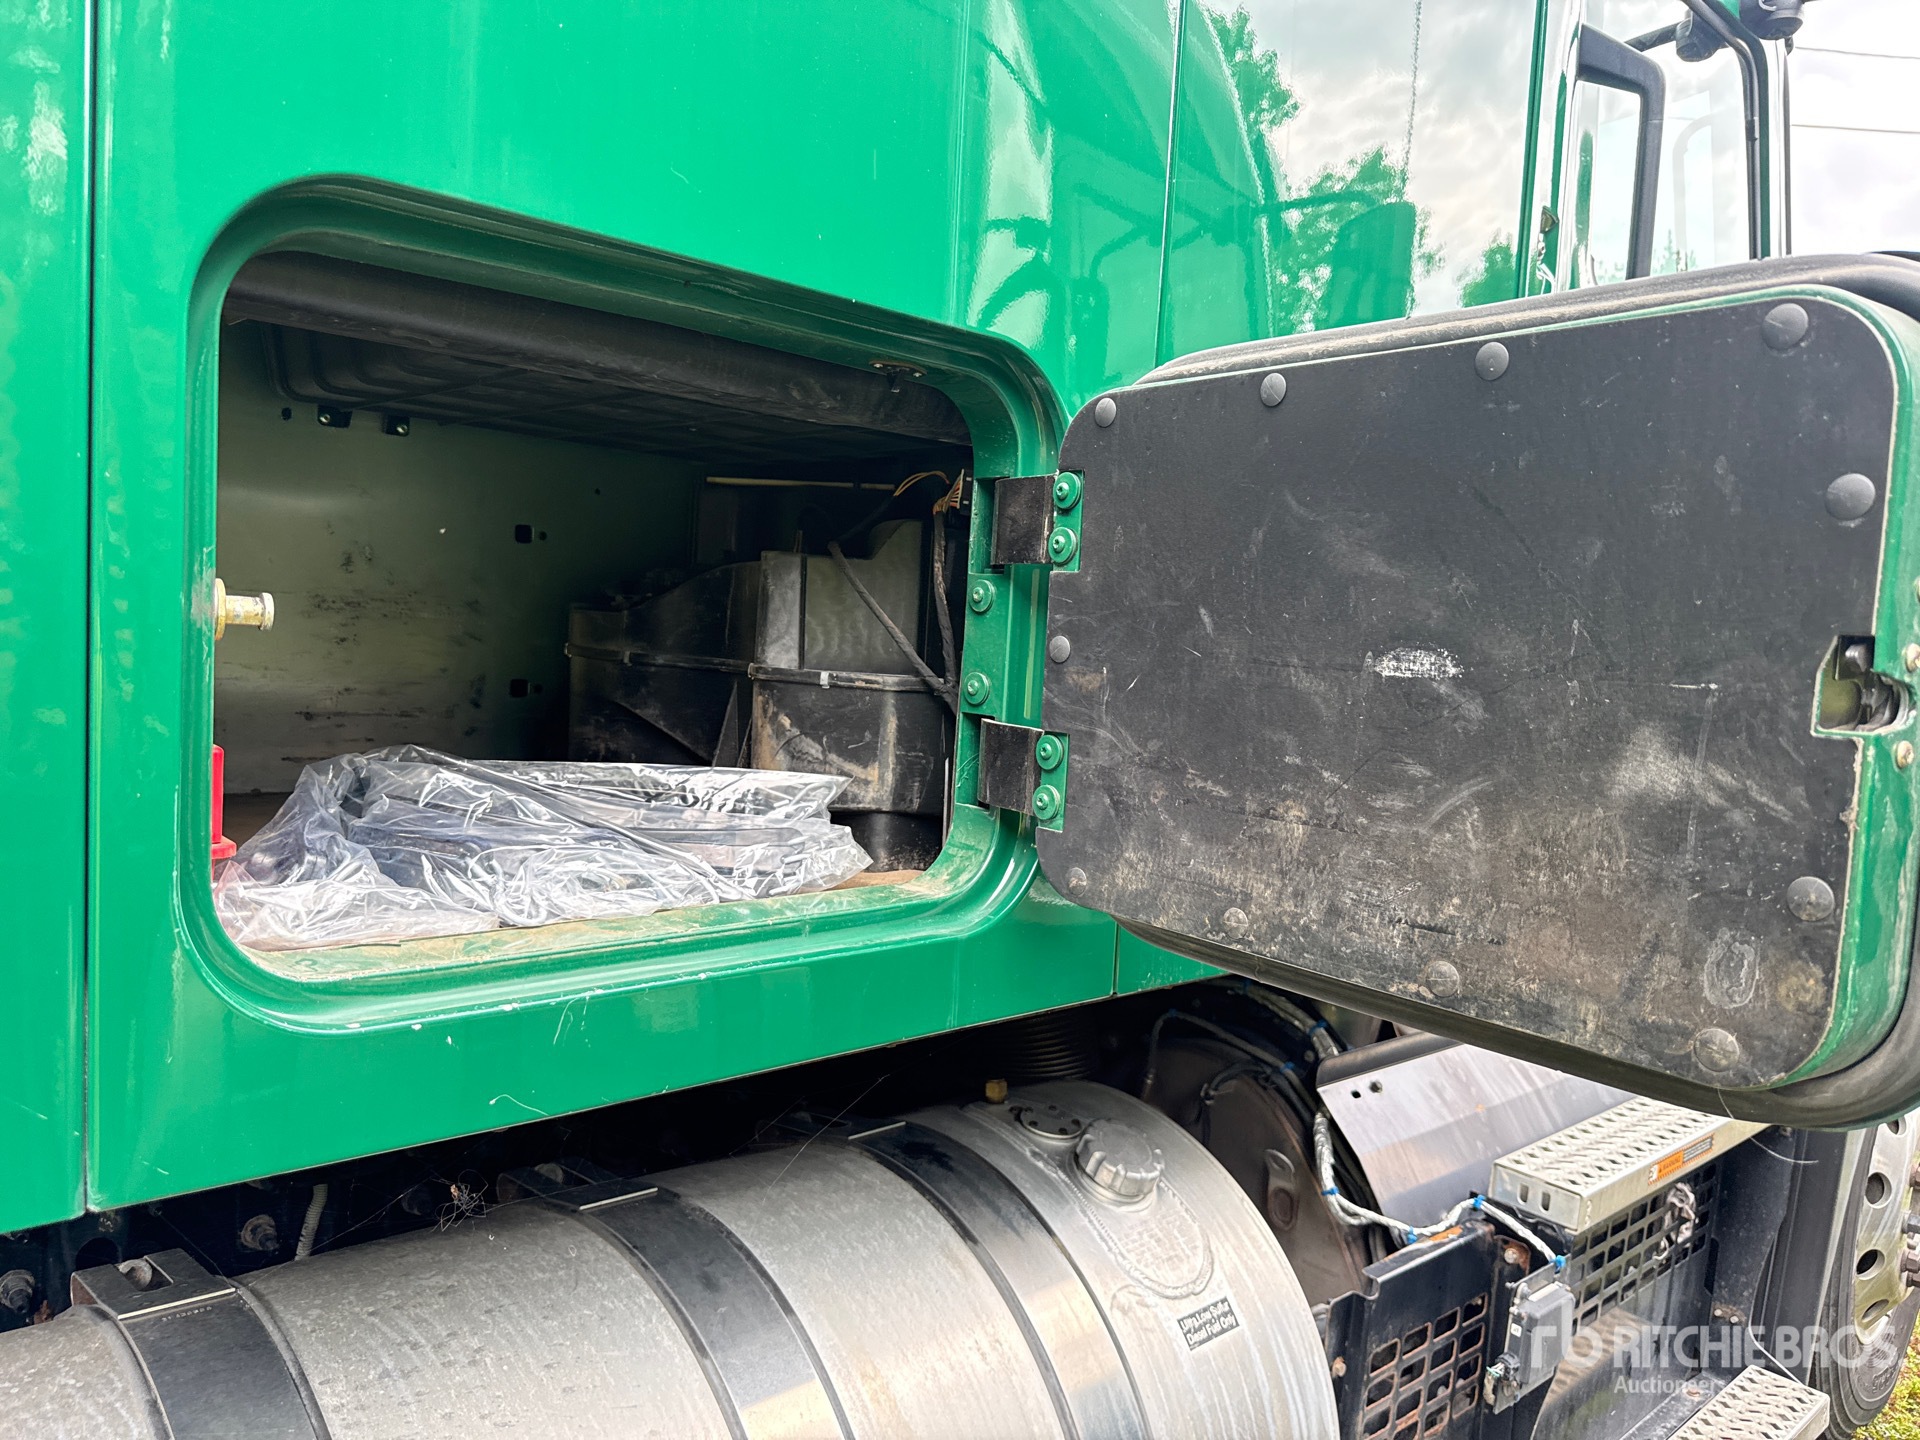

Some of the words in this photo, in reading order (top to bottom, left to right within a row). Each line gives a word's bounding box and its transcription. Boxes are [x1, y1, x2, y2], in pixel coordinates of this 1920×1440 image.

[1186, 1326, 1209, 1345] Diesel
[1205, 1319, 1222, 1336] Fuel
[1219, 1313, 1237, 1328] Only
[1196, 1311, 1212, 1325] Low
